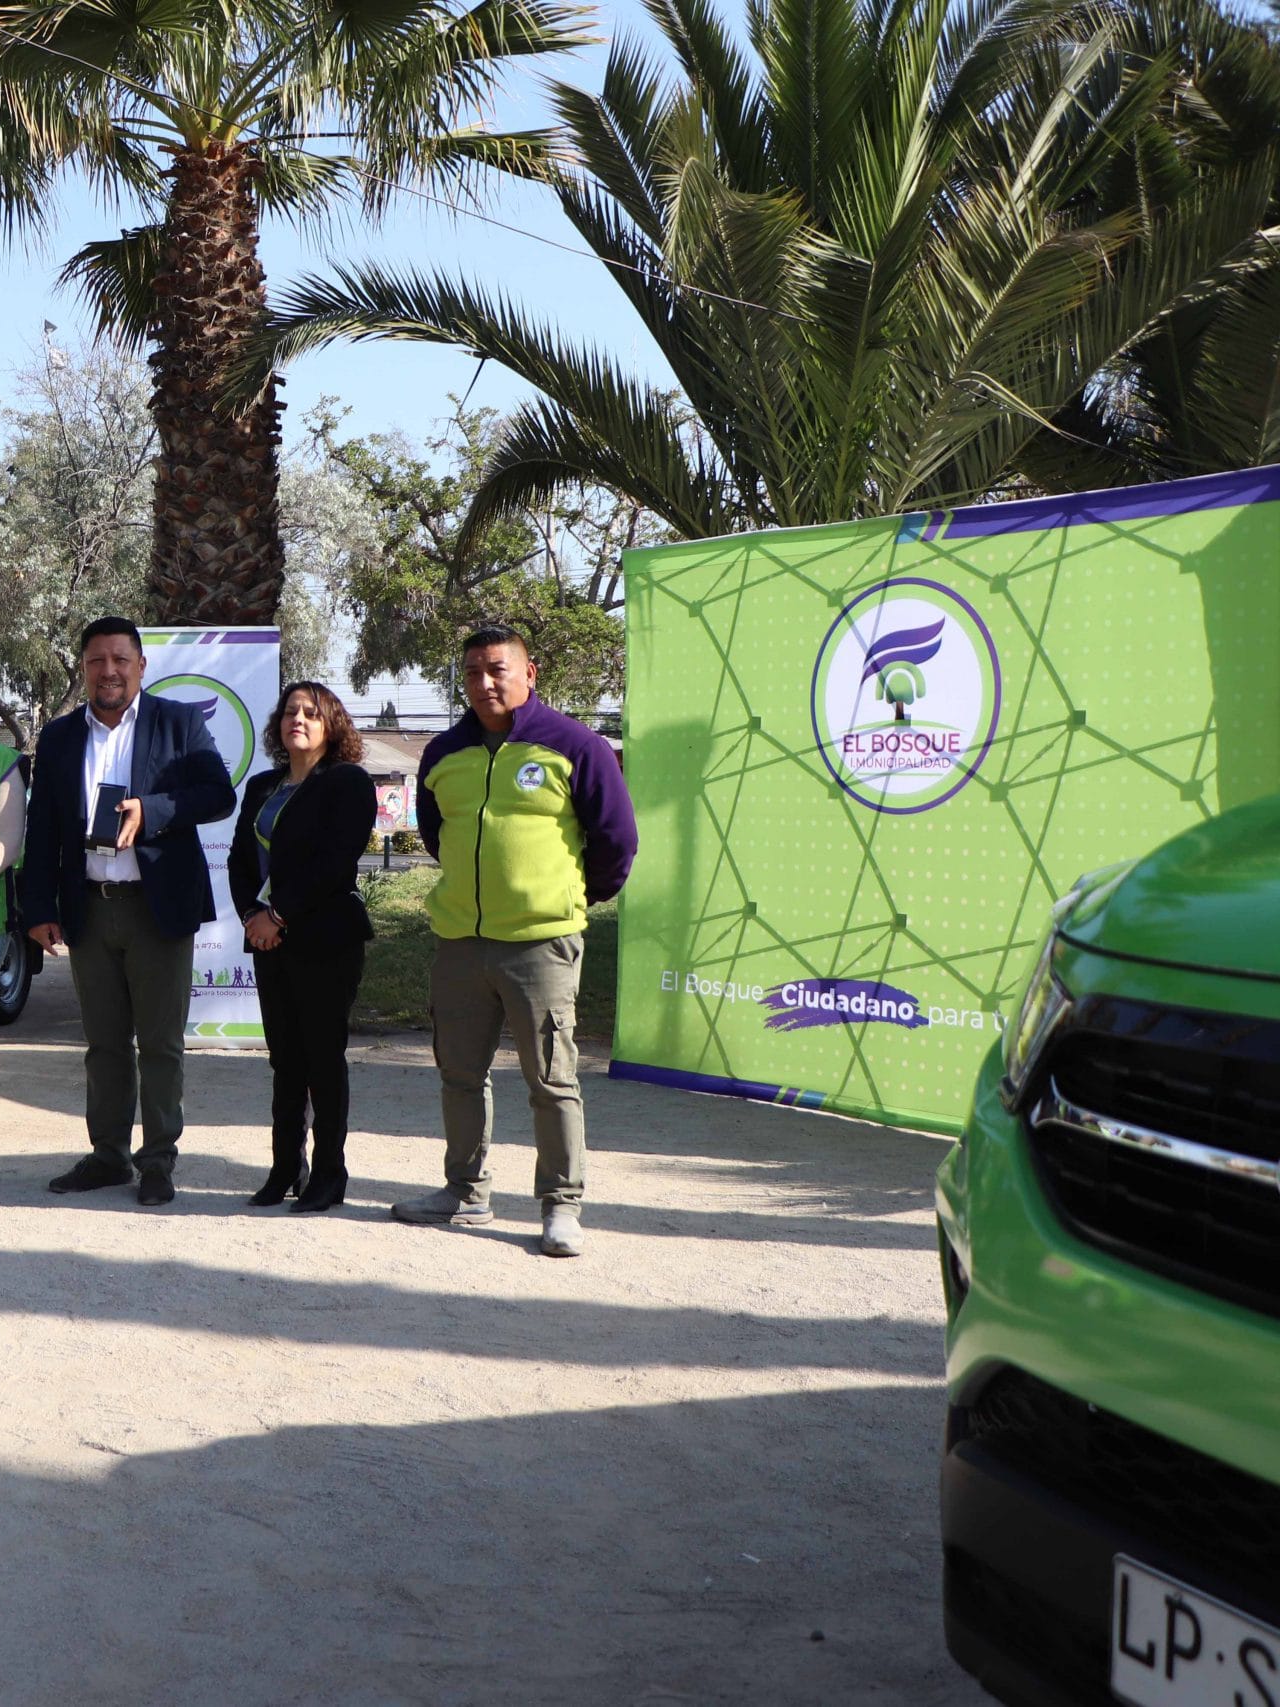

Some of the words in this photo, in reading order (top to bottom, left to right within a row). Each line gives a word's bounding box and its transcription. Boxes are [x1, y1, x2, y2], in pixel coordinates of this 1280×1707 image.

[843, 734, 866, 752] EL
[871, 732, 961, 756] BOSQUE
[850, 756, 951, 769] I.MUNICIPALIDAD
[661, 970, 679, 992] El
[685, 973, 764, 1004] Bosque
[781, 983, 914, 1020] Ciudadano
[928, 1005, 983, 1029] para
